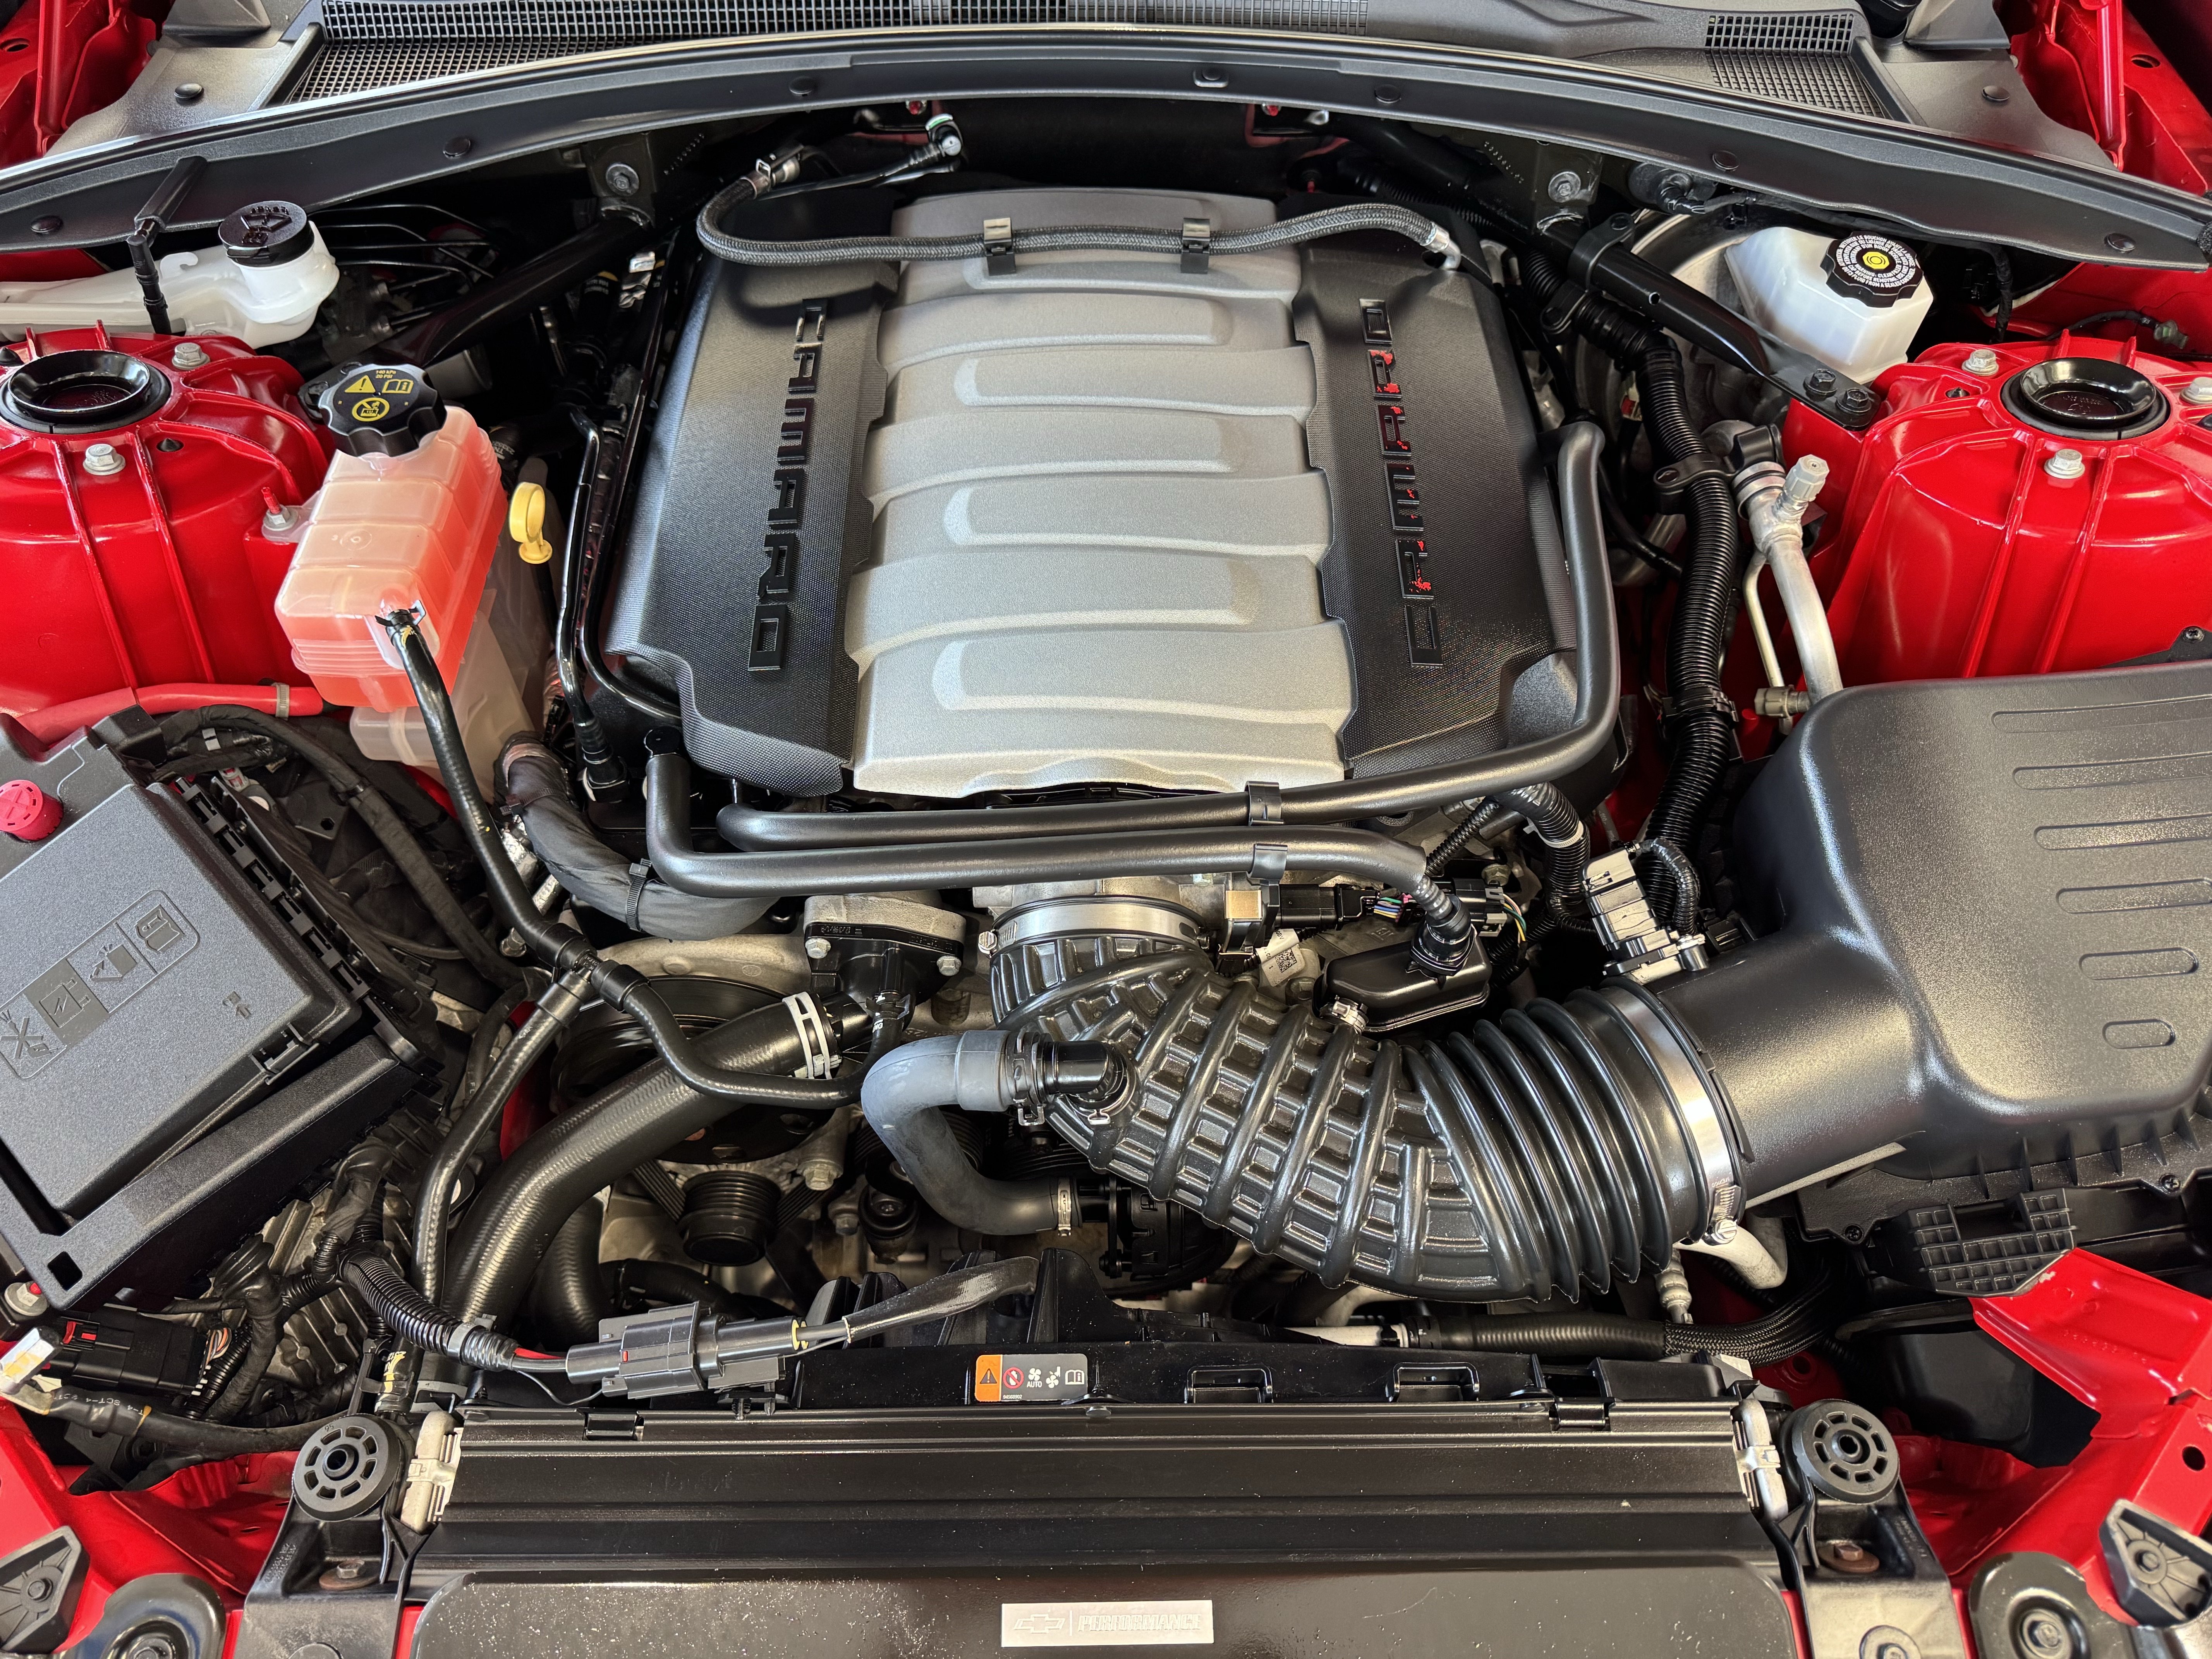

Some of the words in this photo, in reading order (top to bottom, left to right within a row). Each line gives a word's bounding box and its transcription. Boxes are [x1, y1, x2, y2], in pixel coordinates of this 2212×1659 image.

[748, 298, 828, 672] CAMARO
[1359, 298, 1443, 667] CAMARO
[1078, 1614, 1201, 1632] PERFORMANCE
